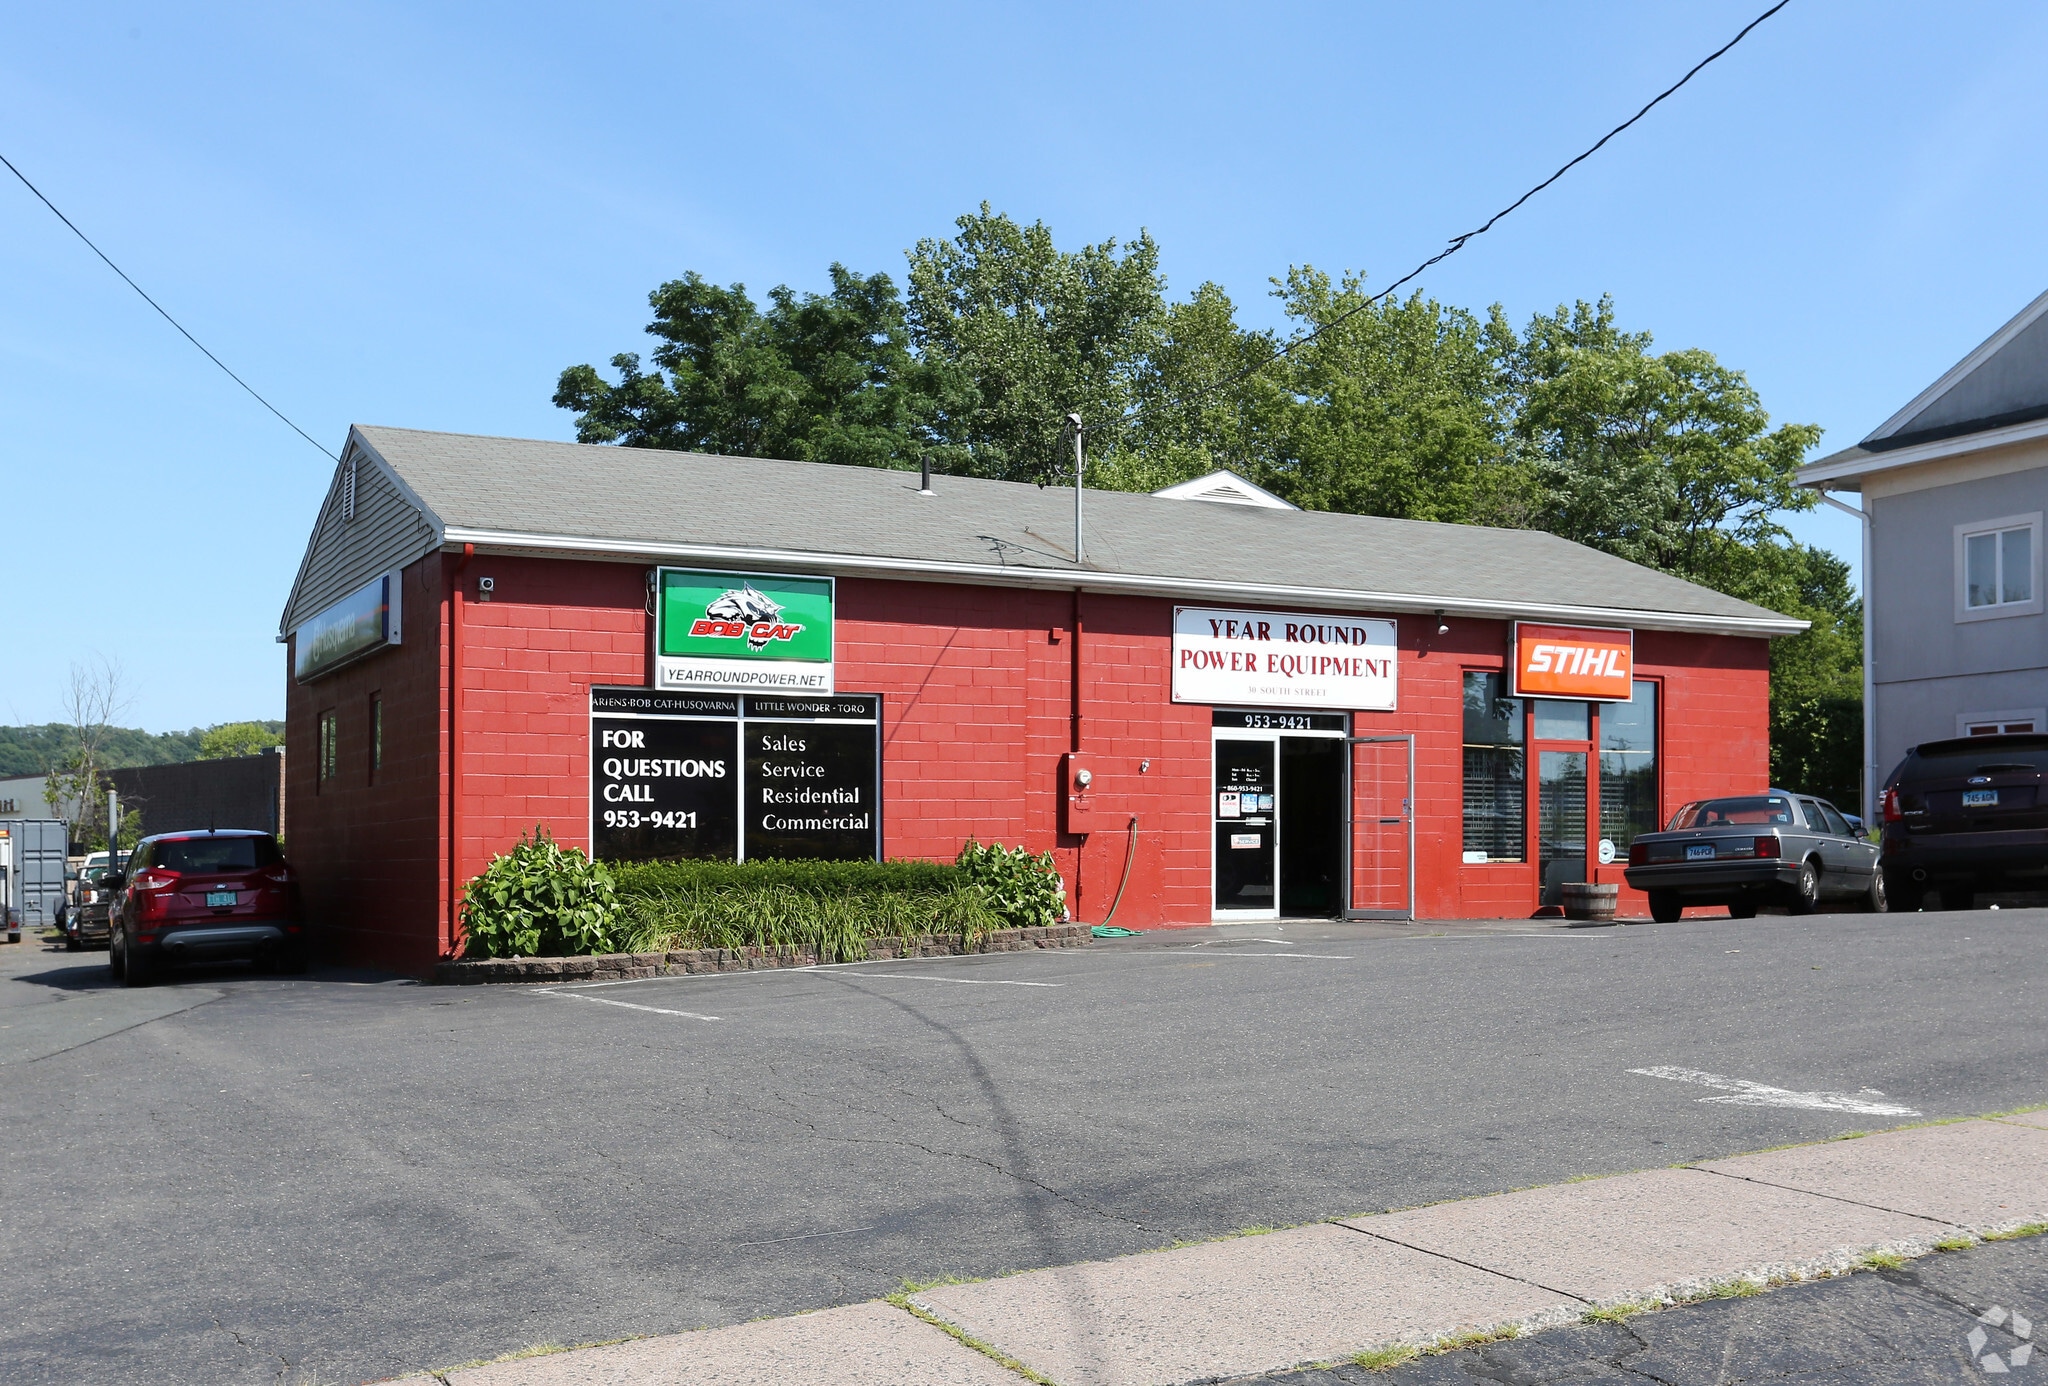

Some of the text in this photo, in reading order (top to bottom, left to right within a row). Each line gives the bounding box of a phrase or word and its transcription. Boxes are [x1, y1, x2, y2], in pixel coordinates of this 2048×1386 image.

[690, 620, 801, 640] BOB CAT
[1209, 618, 1367, 647] YEAR ROUND
[1180, 649, 1391, 678] POWER EQUIPMENT
[1526, 644, 1626, 678] STIHL
[668, 668, 826, 686] YEARROUNDPOWER.NET
[1260, 687, 1290, 695] SOUTH
[1294, 688, 1327, 697] STREET
[755, 702, 785, 711] LITTLE
[787, 703, 830, 712] WONDER
[838, 704, 865, 714] TORO
[1245, 714, 1312, 730] 953-9421
[602, 730, 645, 748] FOR
[762, 734, 806, 752] Sales
[603, 758, 726, 780] QUESTIONS
[762, 761, 825, 778] Service
[603, 784, 654, 802] CALL
[762, 786, 860, 805] Residential
[604, 810, 697, 829] 953-9421
[762, 813, 870, 831] Commercial
